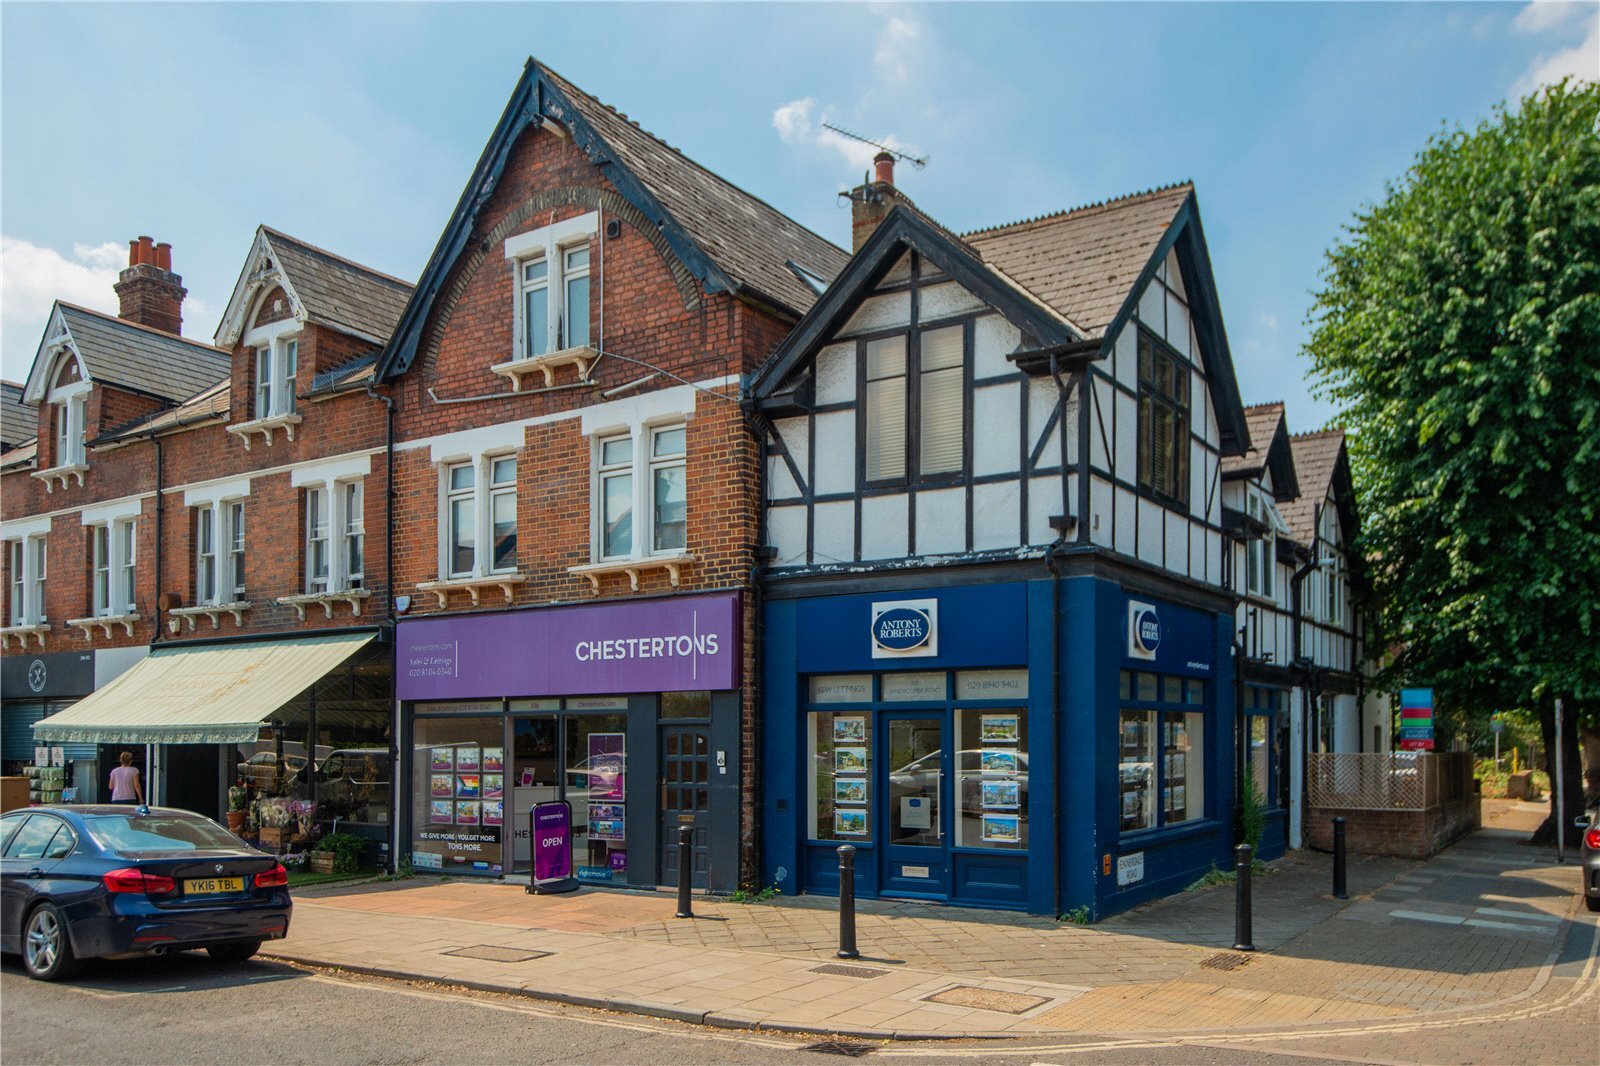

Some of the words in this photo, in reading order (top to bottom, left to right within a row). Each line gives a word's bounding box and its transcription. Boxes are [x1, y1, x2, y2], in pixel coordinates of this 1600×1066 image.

[881, 619, 921, 630] ANTONY
[880, 628, 922, 639] ROBERTS
[575, 633, 719, 662] CHESTERTONS
[409, 668, 421, 677] 020
[817, 685, 833, 694] KEW
[833, 684, 865, 693] LETTINGS
[428, 832, 440, 840] GIVE
[448, 842, 462, 850] TONS
[463, 843, 482, 851] MORE.
[542, 837, 563, 847] OPEN
[579, 869, 606, 878] rightmove
[191, 880, 215, 891] YK16
[217, 879, 238, 890] TBL
